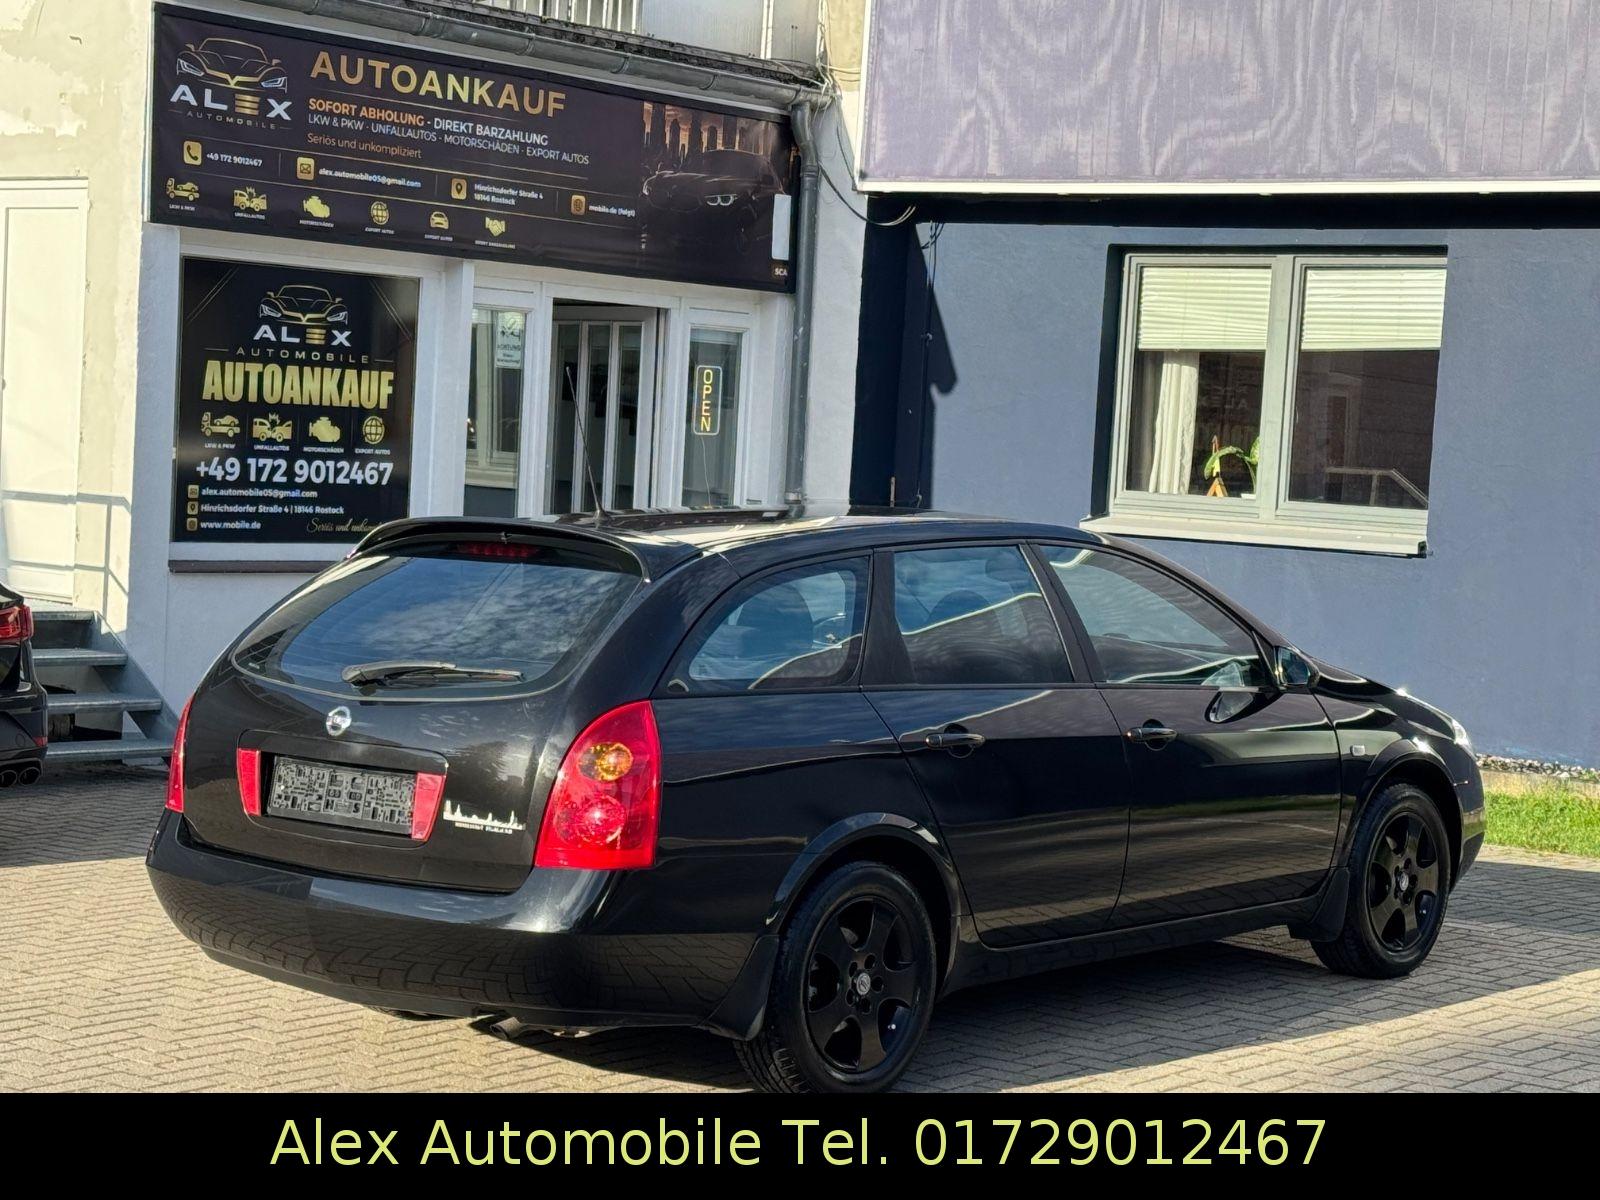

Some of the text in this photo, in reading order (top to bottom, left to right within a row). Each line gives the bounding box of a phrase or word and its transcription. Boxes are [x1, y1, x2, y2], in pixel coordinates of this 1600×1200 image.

[310, 51, 566, 118] AUTOANKAUF
[169, 84, 292, 121] ALEX
[186, 111, 277, 130] AUTOMOBILE
[308, 98, 357, 116] SOFORT
[360, 106, 424, 127] ABHOLUNG
[434, 119, 473, 135] DIREKT
[476, 125, 548, 146] BARZAHLUNG
[308, 114, 331, 127] LKW
[332, 118, 339, 127] &
[341, 118, 364, 131] PKW
[371, 123, 437, 142] UNFALLAUTOS
[444, 133, 520, 154] MOTORSCHÄDEN
[526, 146, 560, 161] EXPORT
[561, 151, 589, 165] AUTOS
[338, 138, 357, 149] und
[359, 141, 422, 159] unkompliziert
[220, 154, 232, 162] 172
[253, 324, 352, 347] ALEX
[236, 346, 369, 364] AUTOMOBILE
[202, 360, 395, 410] AUTOANKAUF
[701, 369, 713, 432] OPEN
[196, 456, 394, 486] +49 172 9012467
[201, 487, 318, 500] alex.automobile05@gmail.com
[201, 504, 257, 514] Hinrichsdorfer
[258, 504, 283, 514] Straße
[284, 505, 289, 514] 4
[315, 506, 344, 515] Rostock
[200, 520, 261, 530] www.mobile.de
